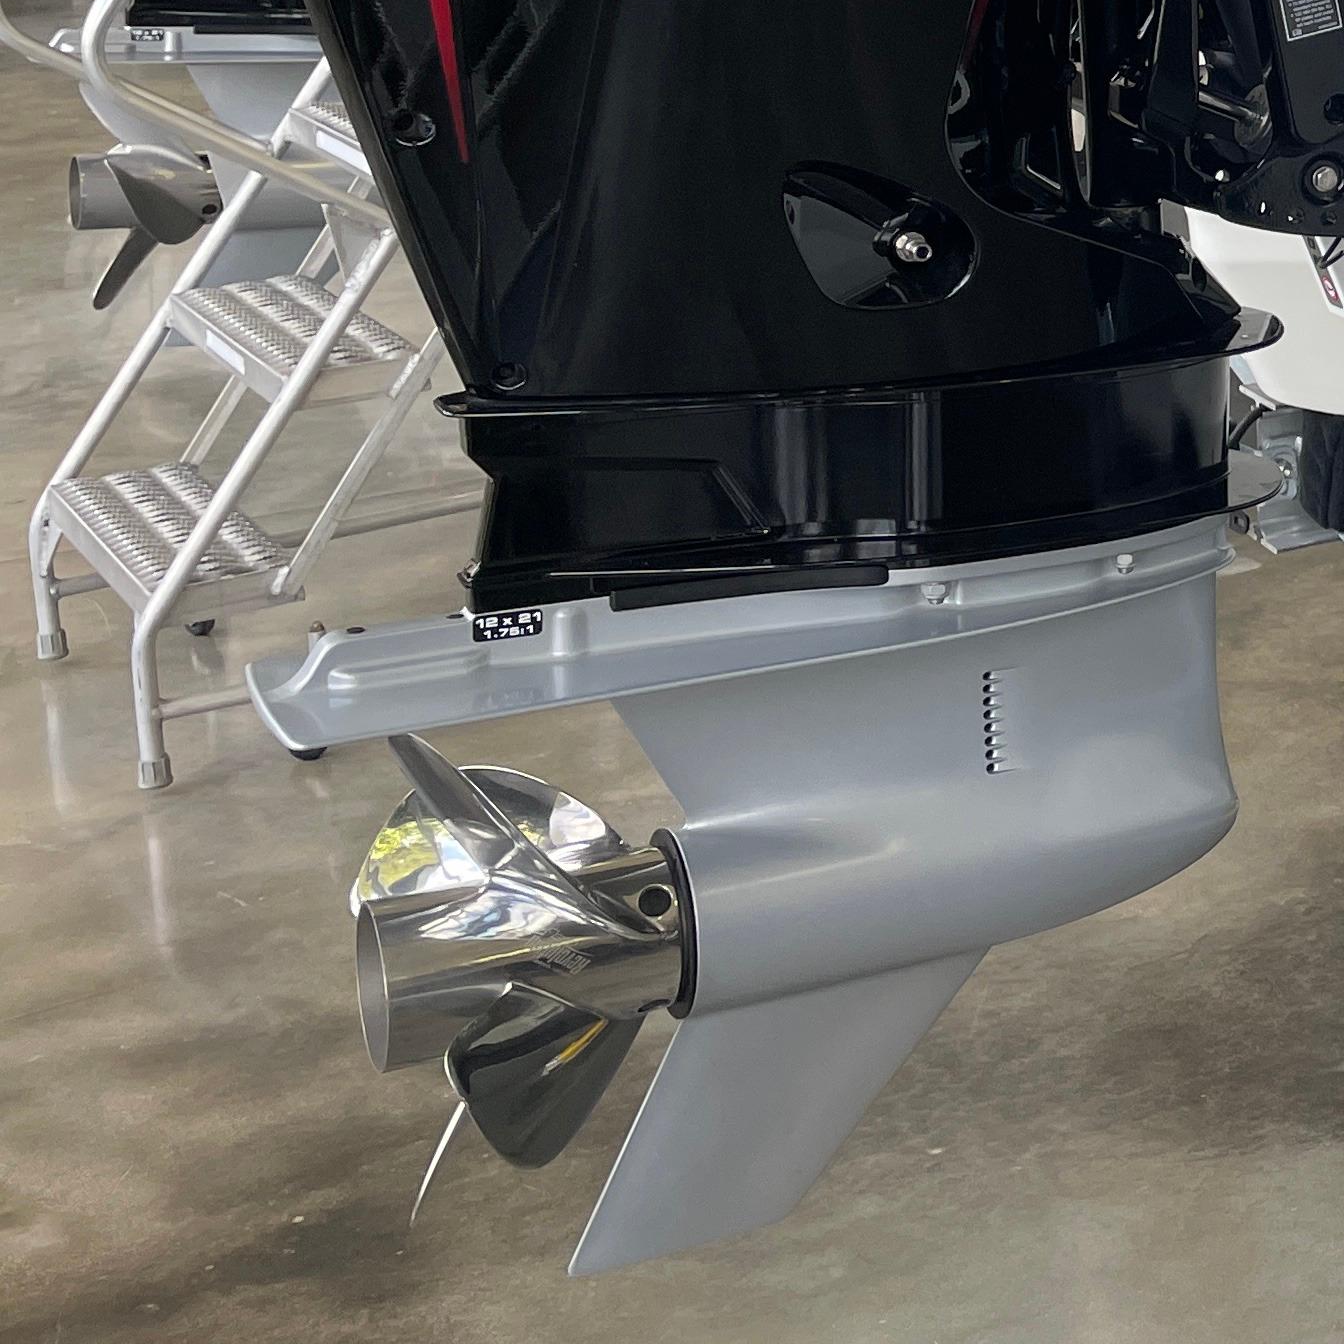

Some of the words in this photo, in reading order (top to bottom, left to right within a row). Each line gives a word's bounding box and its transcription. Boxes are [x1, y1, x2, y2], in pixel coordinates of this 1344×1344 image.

[476, 616, 498, 628] 12
[503, 617, 513, 625] x
[518, 612, 542, 624] 21
